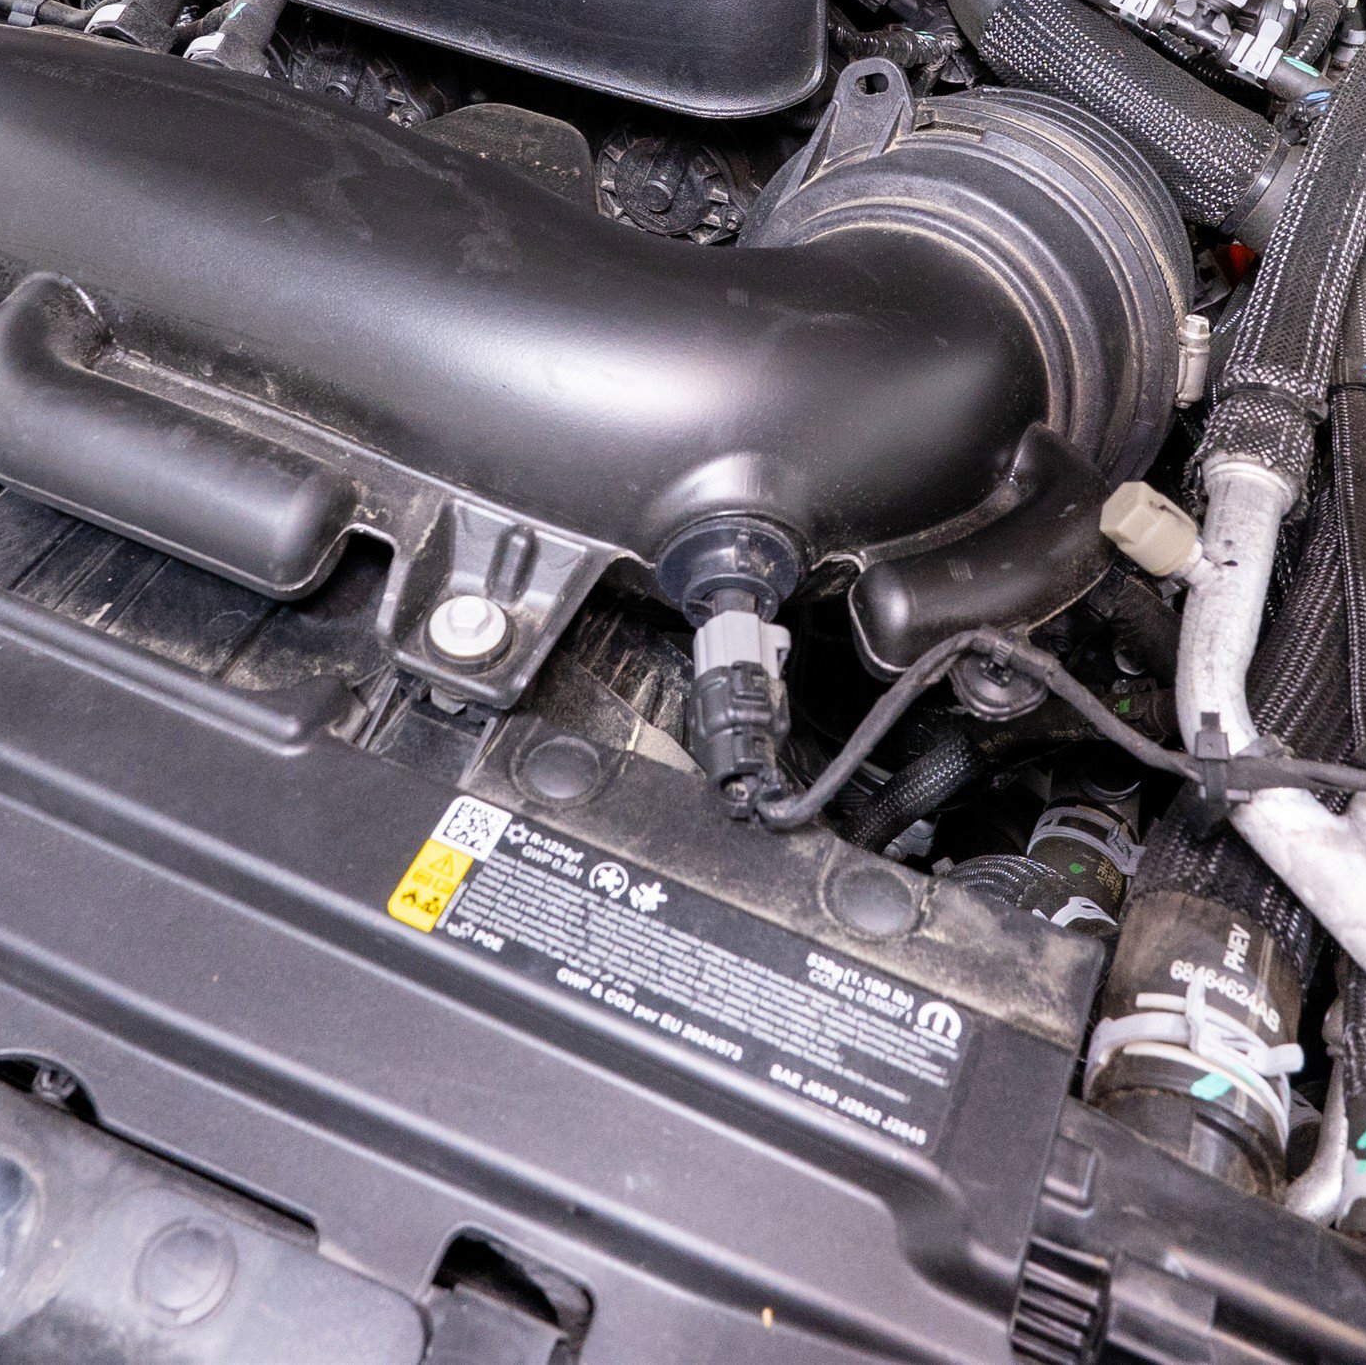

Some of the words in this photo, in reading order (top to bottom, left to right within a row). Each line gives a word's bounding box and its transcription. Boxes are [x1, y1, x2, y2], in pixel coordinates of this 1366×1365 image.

[520, 843, 554, 866] GWP
[472, 927, 505, 953] POE
[1222, 921, 1252, 974] PHEV
[554, 965, 592, 993] GWP
[589, 982, 604, 998] &
[601, 987, 636, 1013] CO2
[631, 1002, 660, 1026] per
[657, 1012, 683, 1034] EU
[767, 1062, 804, 1089] SAE
